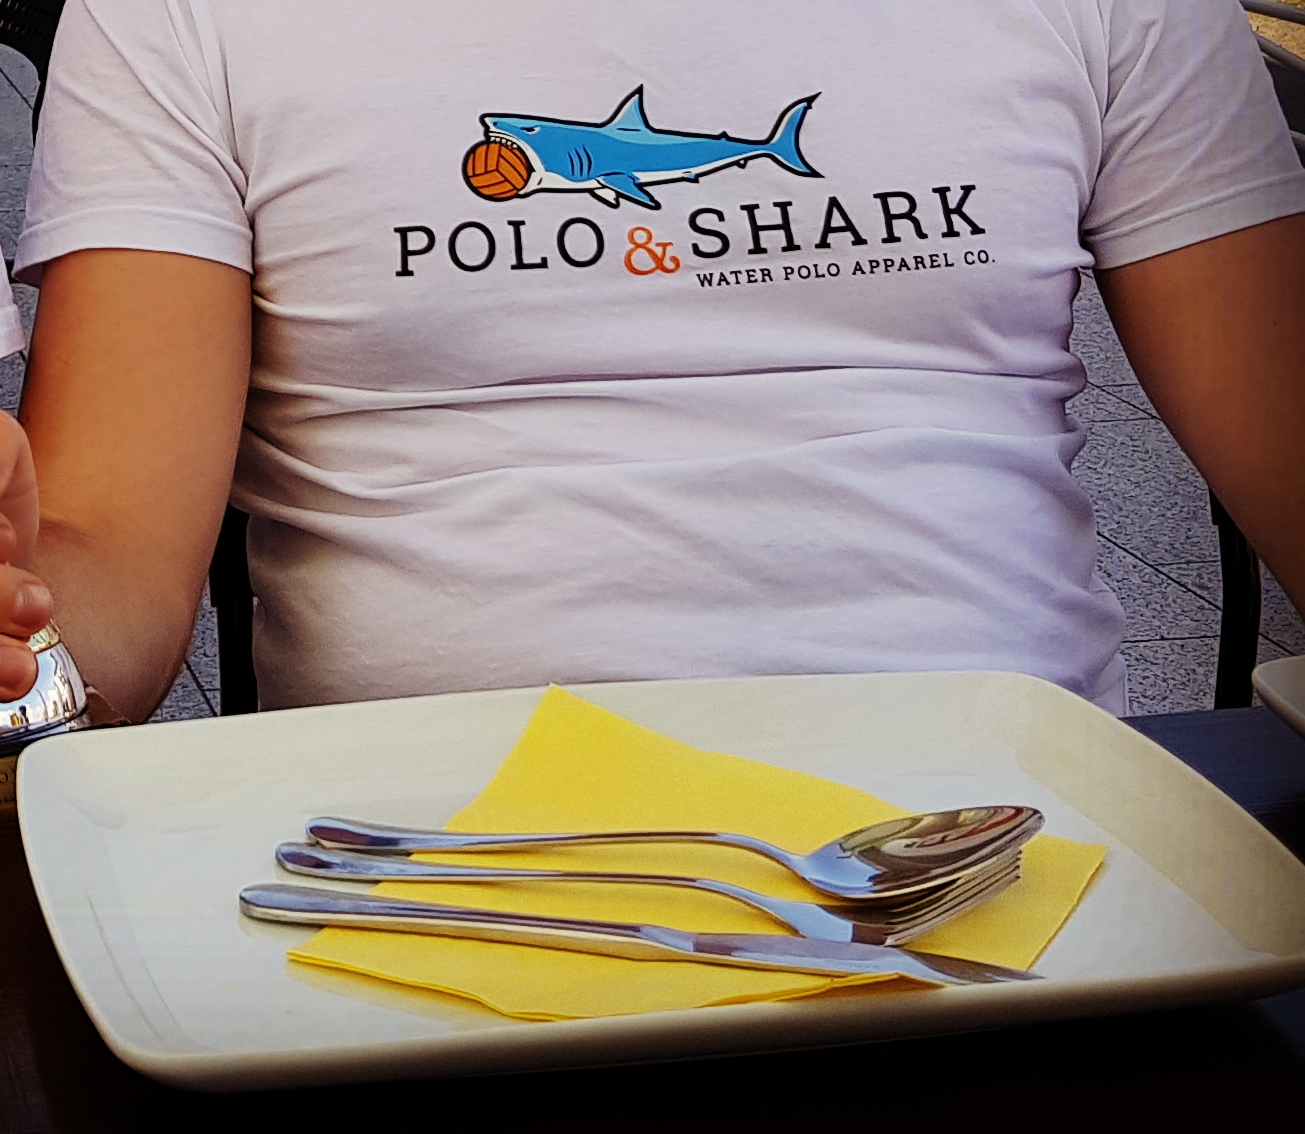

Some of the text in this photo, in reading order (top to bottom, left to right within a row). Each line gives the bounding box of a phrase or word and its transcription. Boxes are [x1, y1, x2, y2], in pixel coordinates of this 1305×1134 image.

[394, 183, 986, 277] POLO & SHARK
[696, 250, 996, 288] WATER POLO APPAREL CO.
